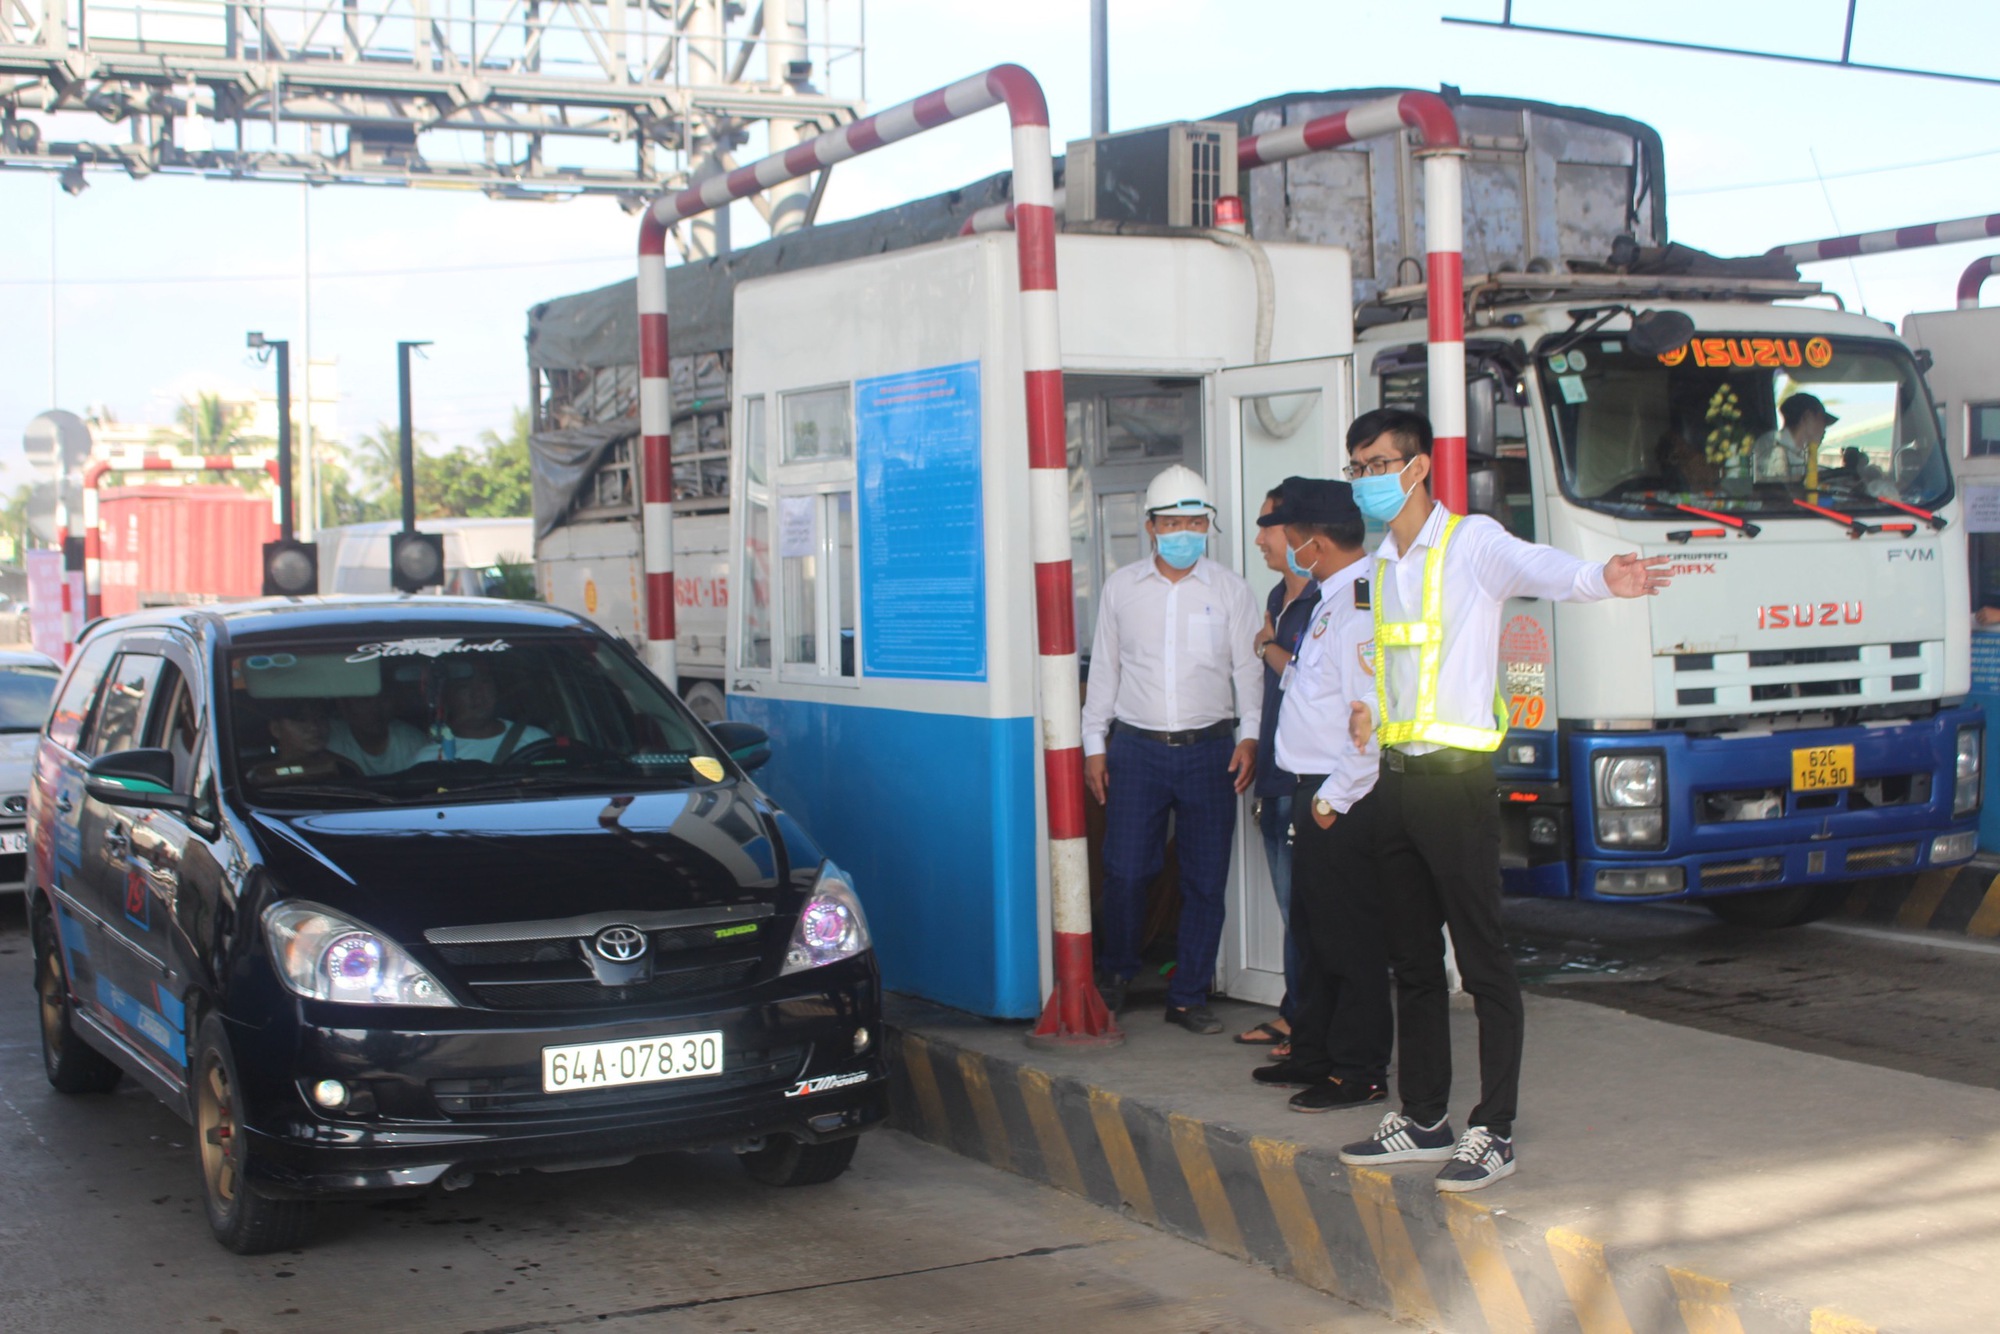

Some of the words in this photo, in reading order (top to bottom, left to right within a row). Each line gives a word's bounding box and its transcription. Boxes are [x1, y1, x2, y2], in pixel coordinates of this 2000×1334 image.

[1690, 338, 1802, 368] ISUZU
[1887, 548, 1935, 562] FVM
[1757, 600, 1863, 630] ISUZU
[1508, 695, 1546, 730] 79
[1809, 749, 1837, 768] 62C
[1801, 767, 1848, 788] 154.90
[552, 1037, 716, 1086] 64A-078.30
